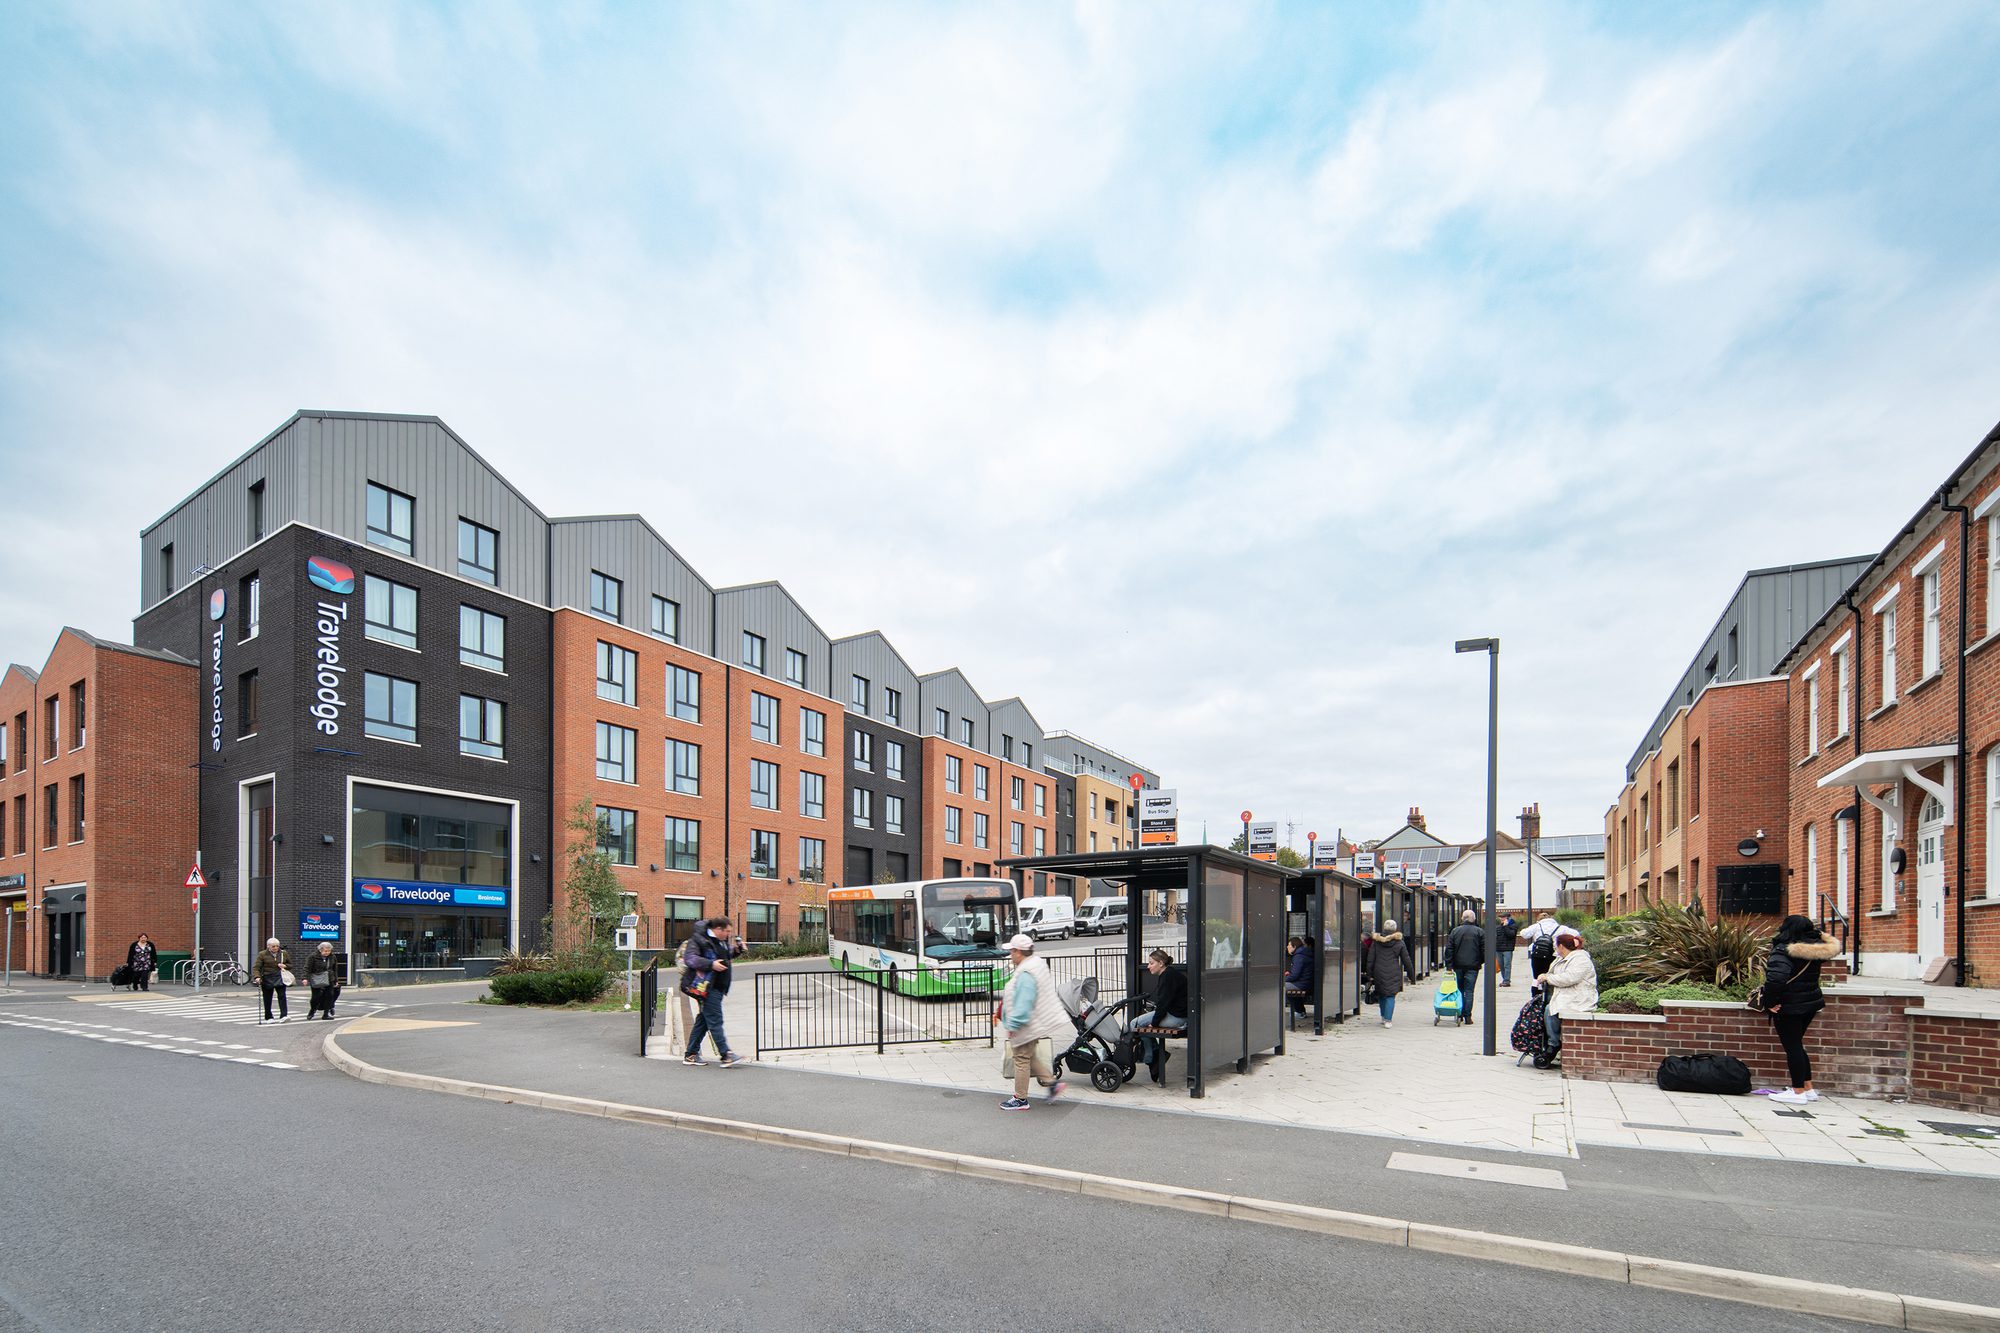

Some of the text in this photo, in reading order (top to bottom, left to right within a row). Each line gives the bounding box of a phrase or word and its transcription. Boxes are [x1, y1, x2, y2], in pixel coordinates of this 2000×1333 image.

[310, 601, 347, 735] Travelodge
[211, 623, 224, 752] Travelodge
[386, 886, 451, 903] Travelodge
[477, 894, 503, 902] Braintree
[302, 922, 339, 931] Travelodge
